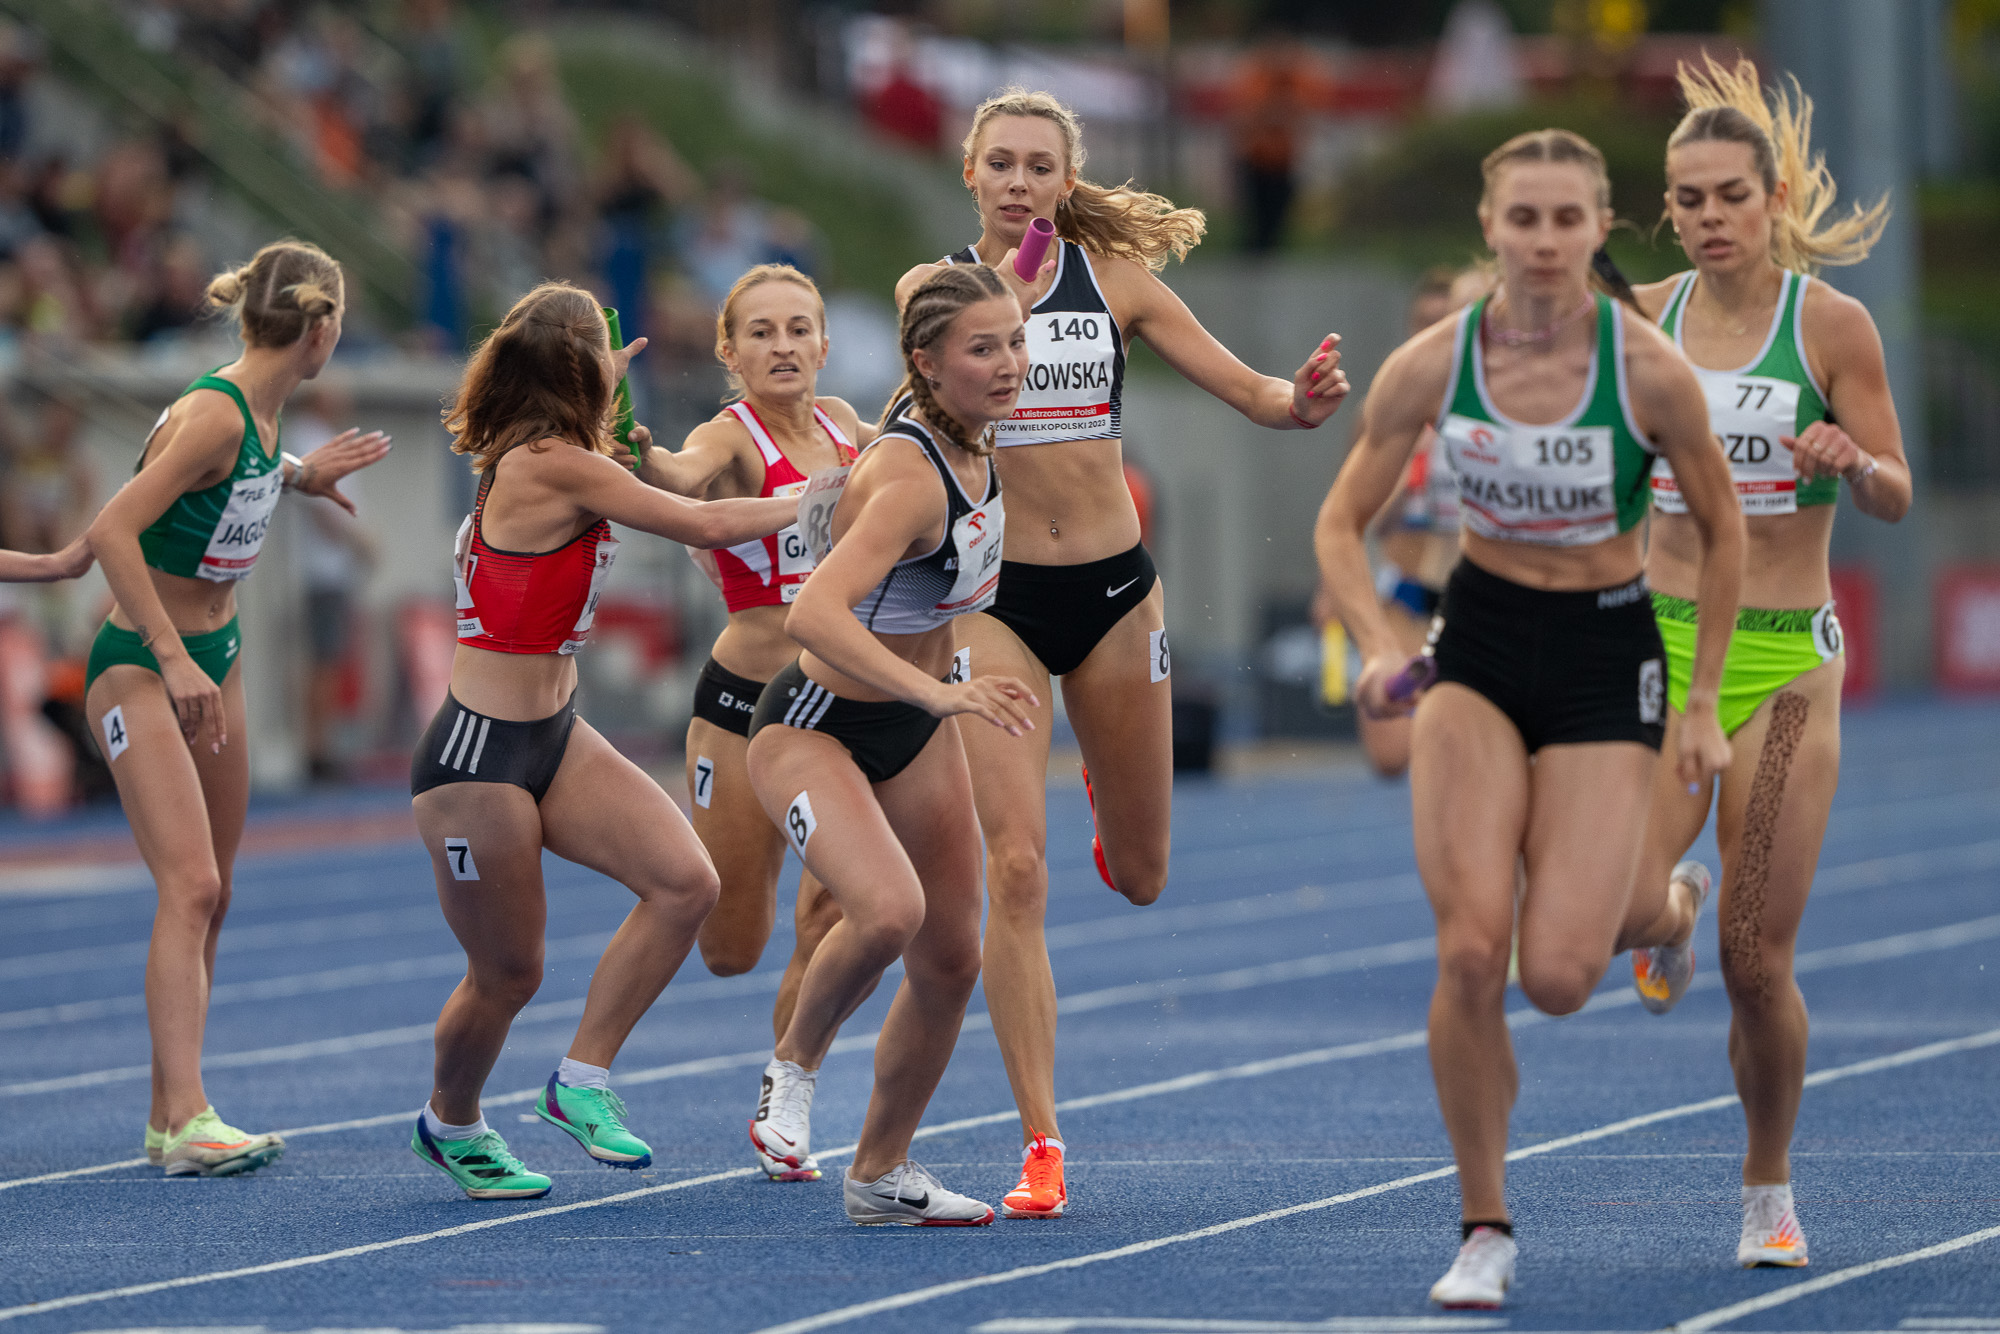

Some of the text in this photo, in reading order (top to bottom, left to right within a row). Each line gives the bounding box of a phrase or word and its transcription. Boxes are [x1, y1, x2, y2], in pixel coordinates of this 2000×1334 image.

[1048, 318, 1099, 342] 140
[1737, 384, 1773, 409] 77
[1019, 422, 1087, 431] WIELKOPOLSKI
[1088, 419, 1106, 429] 2023
[1022, 409, 1073, 418] Mistrzostwa
[1074, 406, 1097, 416] Polski
[1537, 436, 1593, 465] 105
[1822, 608, 1840, 652] 6
[1159, 631, 1168, 675] 8
[110, 715, 125, 745] 4
[697, 764, 711, 797] 7
[789, 805, 807, 847] 8
[447, 846, 468, 873] 7
